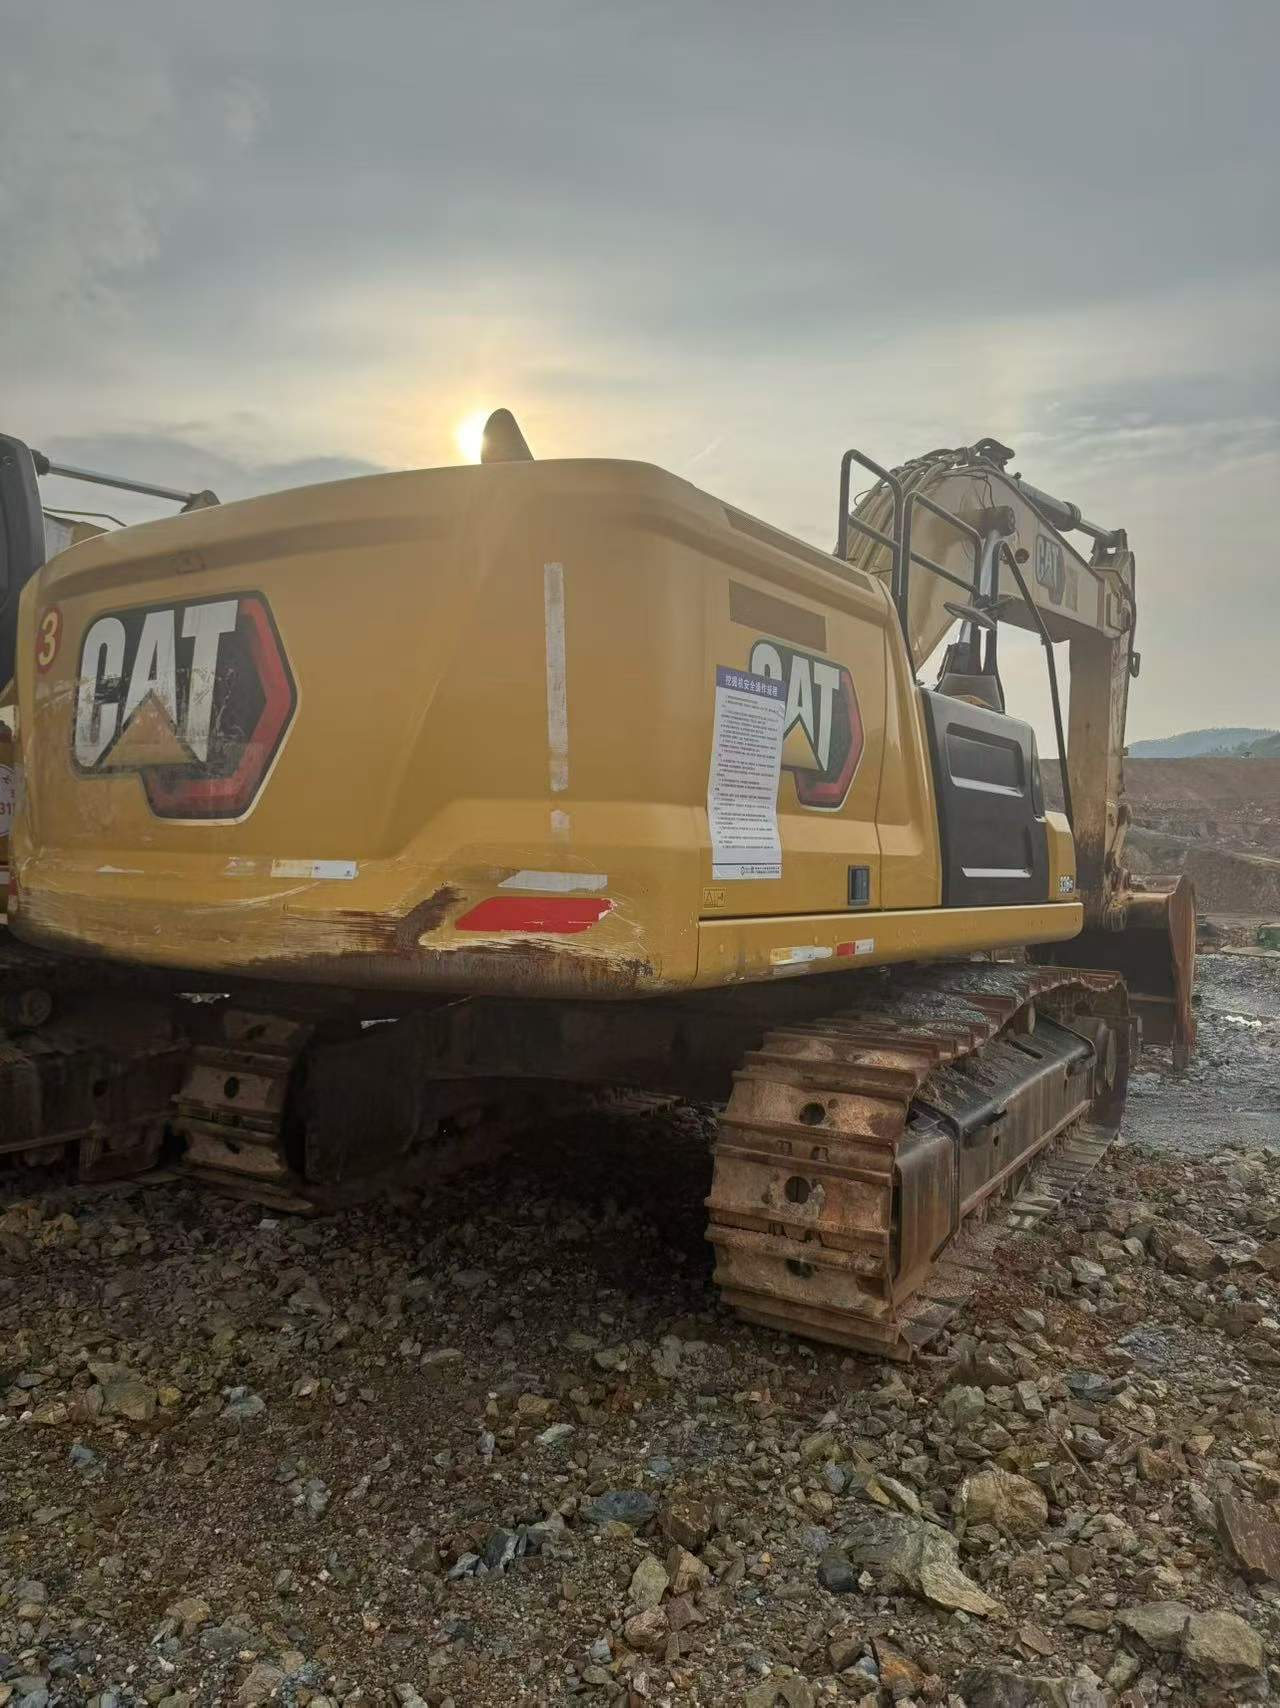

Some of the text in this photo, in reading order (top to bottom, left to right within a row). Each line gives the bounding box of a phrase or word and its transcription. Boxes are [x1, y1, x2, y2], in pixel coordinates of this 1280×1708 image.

[1037, 536, 1059, 588] CAT
[37, 611, 59, 668] 3
[75, 600, 238, 767] CAT
